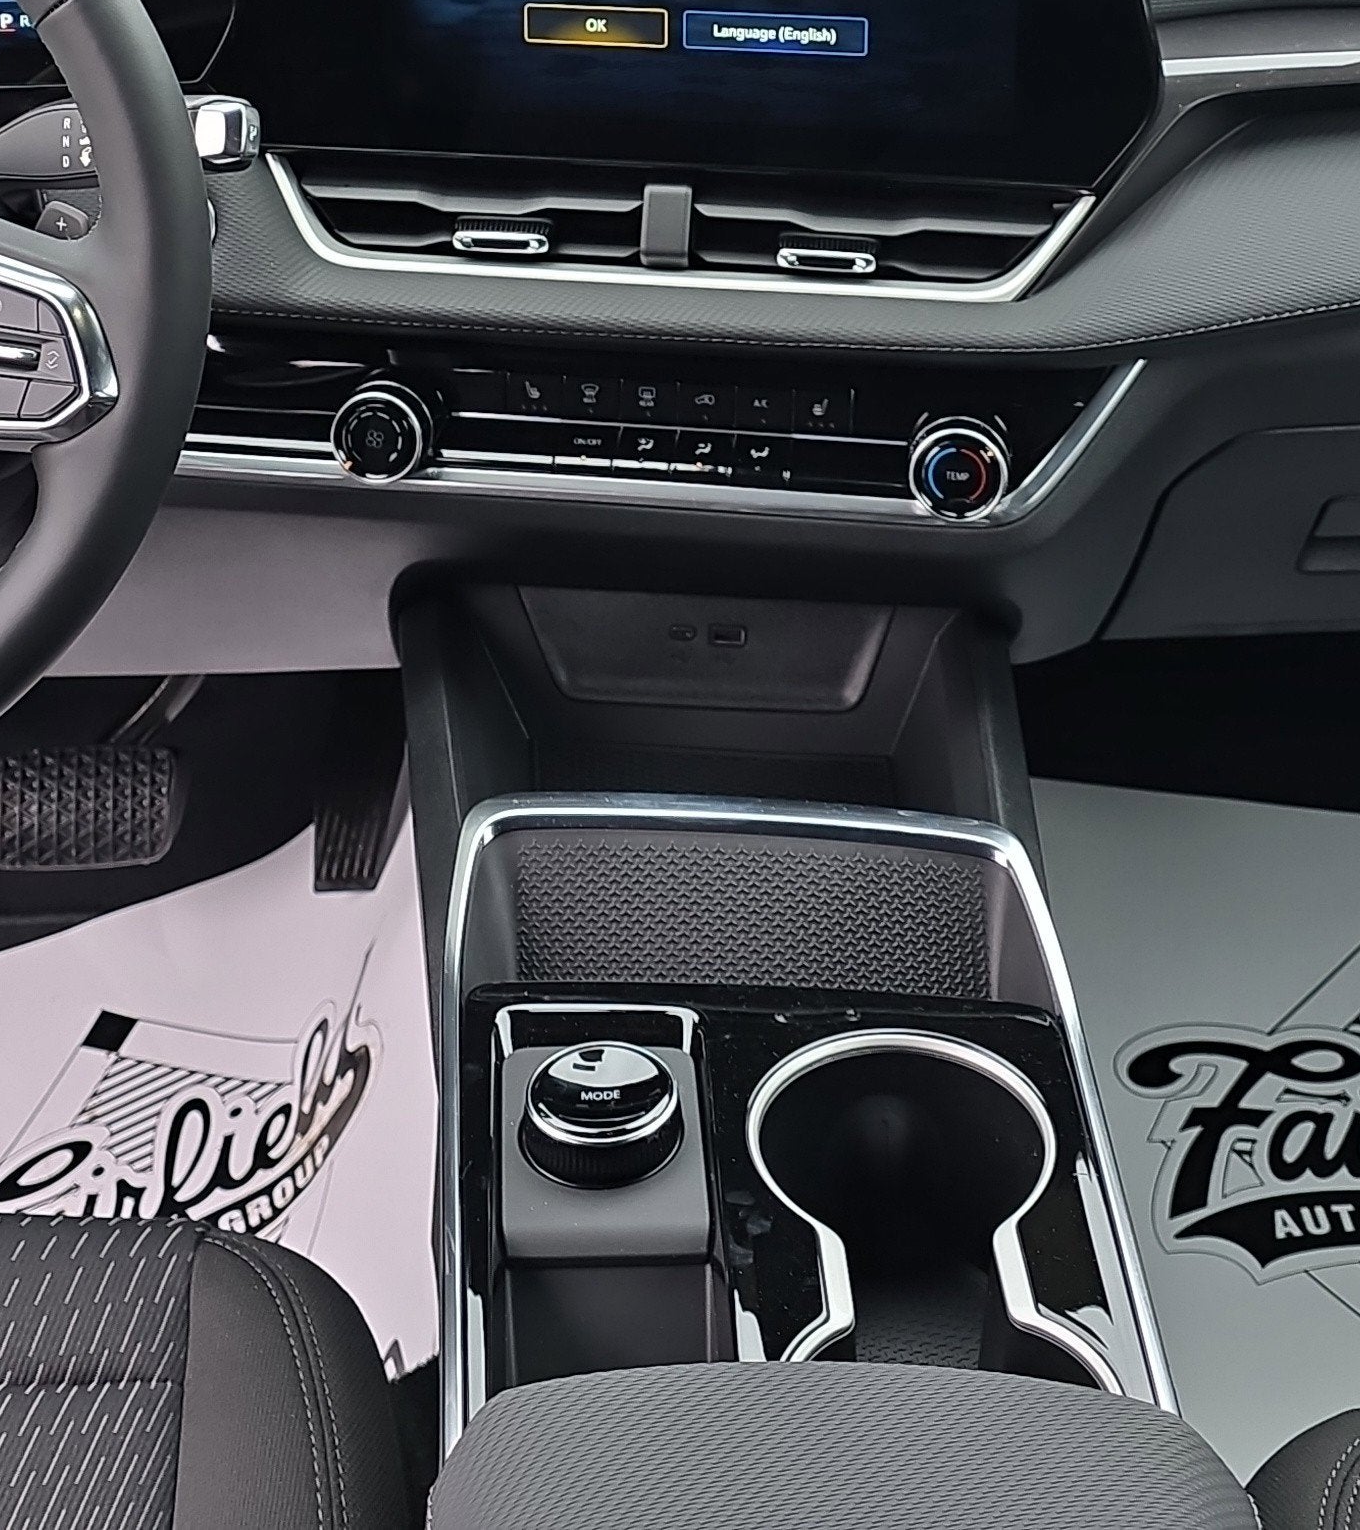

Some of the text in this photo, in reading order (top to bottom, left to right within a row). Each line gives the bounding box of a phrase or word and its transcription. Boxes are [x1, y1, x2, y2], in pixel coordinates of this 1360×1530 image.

[0, 13, 14, 28] P
[584, 17, 608, 33] OK
[713, 23, 837, 46] Language (English)
[63, 117, 71, 130] R
[62, 135, 70, 148] N
[62, 155, 70, 168] D
[580, 1089, 622, 1102] MODE
[216, 1134, 330, 1234] GROUP
